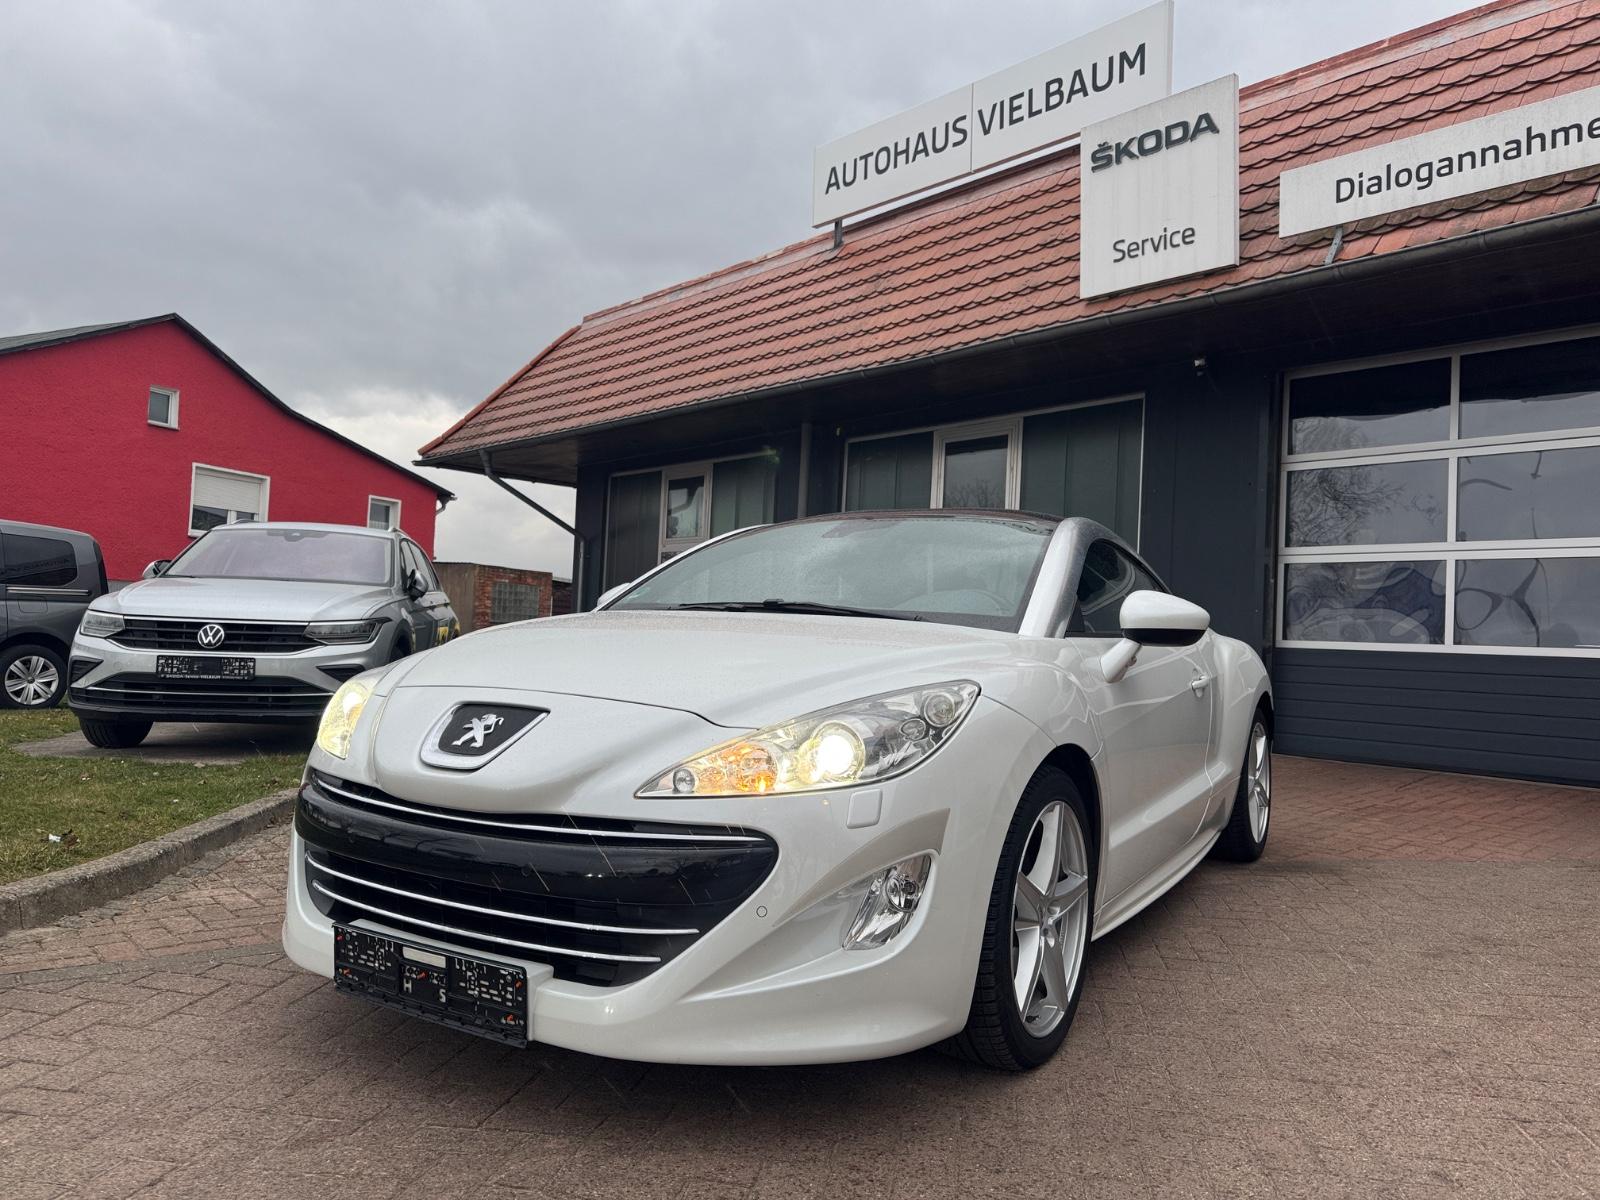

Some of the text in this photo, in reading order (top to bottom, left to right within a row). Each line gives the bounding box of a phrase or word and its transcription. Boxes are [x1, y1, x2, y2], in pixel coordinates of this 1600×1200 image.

[825, 42, 1146, 195] AUTOHAUS VIELBAUM
[1090, 112, 1220, 174] ŠKODA
[1335, 117, 1600, 204] Dialogannahme
[1112, 227, 1196, 264] Service
[197, 623, 225, 649] VW
